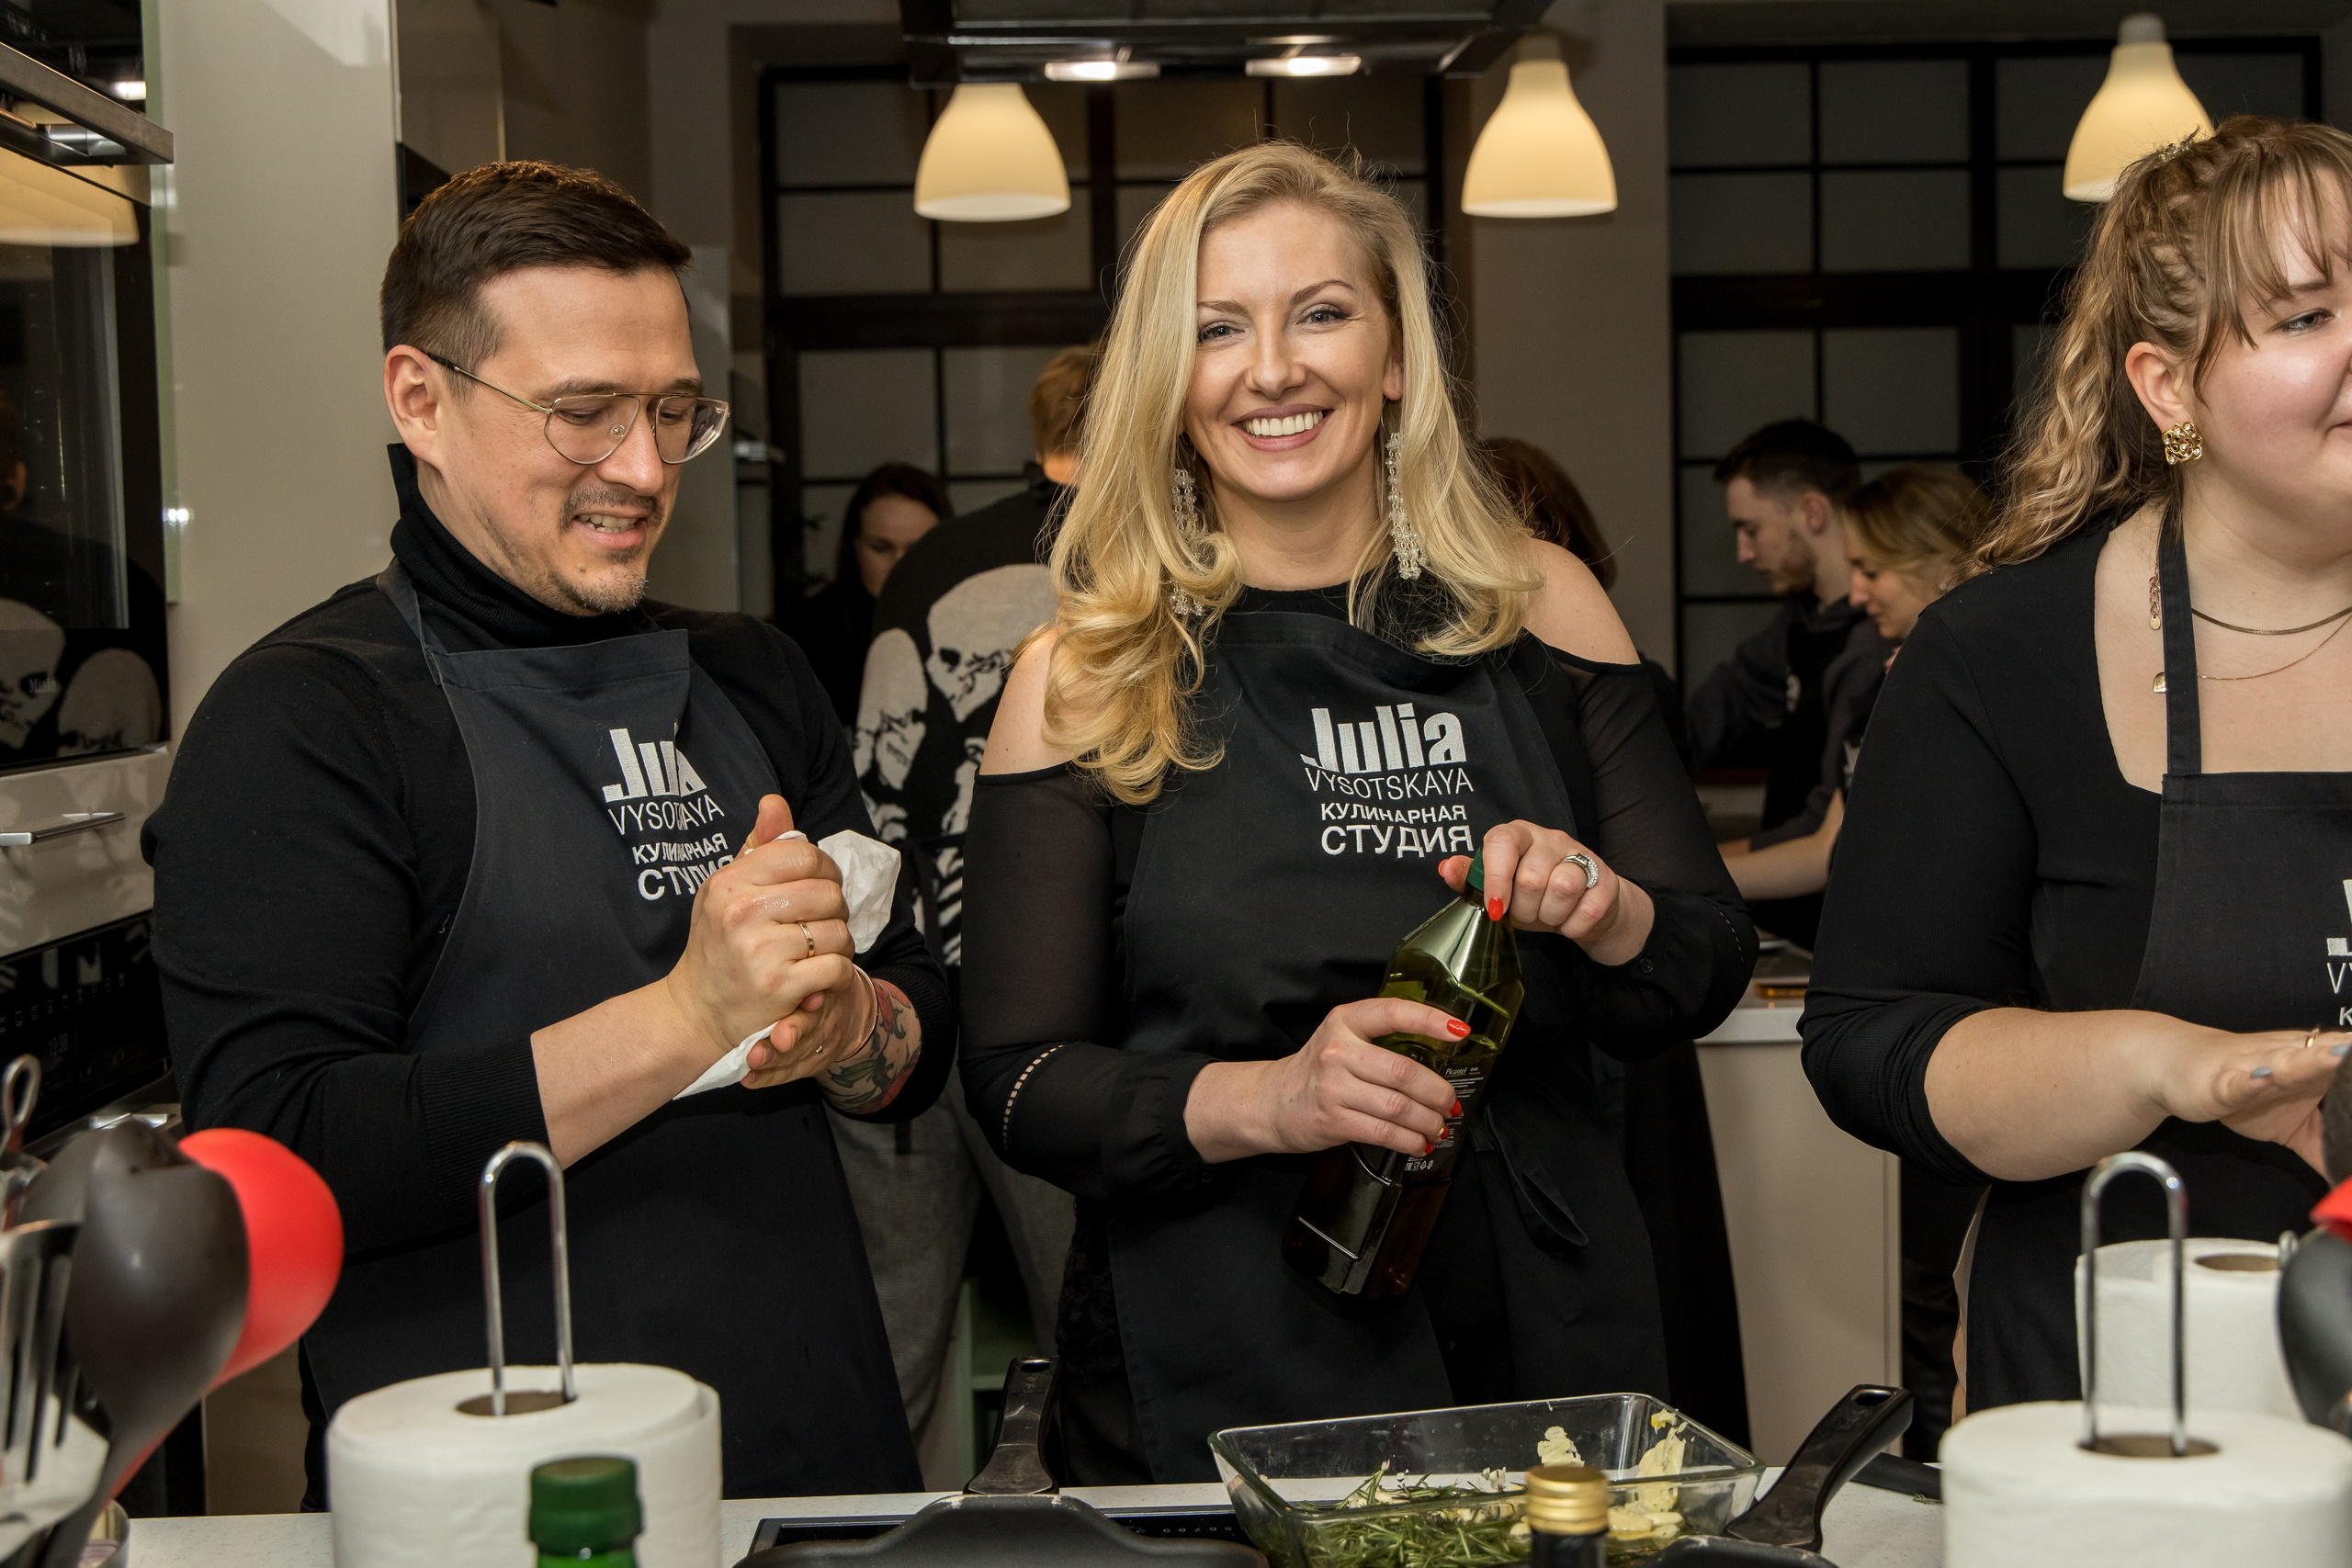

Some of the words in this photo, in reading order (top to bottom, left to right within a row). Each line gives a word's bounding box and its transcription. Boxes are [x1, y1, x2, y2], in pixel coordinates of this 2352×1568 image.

[28, 677, 57, 693] Miele
[1300, 703, 1467, 774] Julia
[1305, 767, 1475, 801] VYSOTSKAYA
[1320, 803, 1468, 825] КУЛИНАРНАЯ
[1321, 825, 1475, 859] СТУДИЯ
